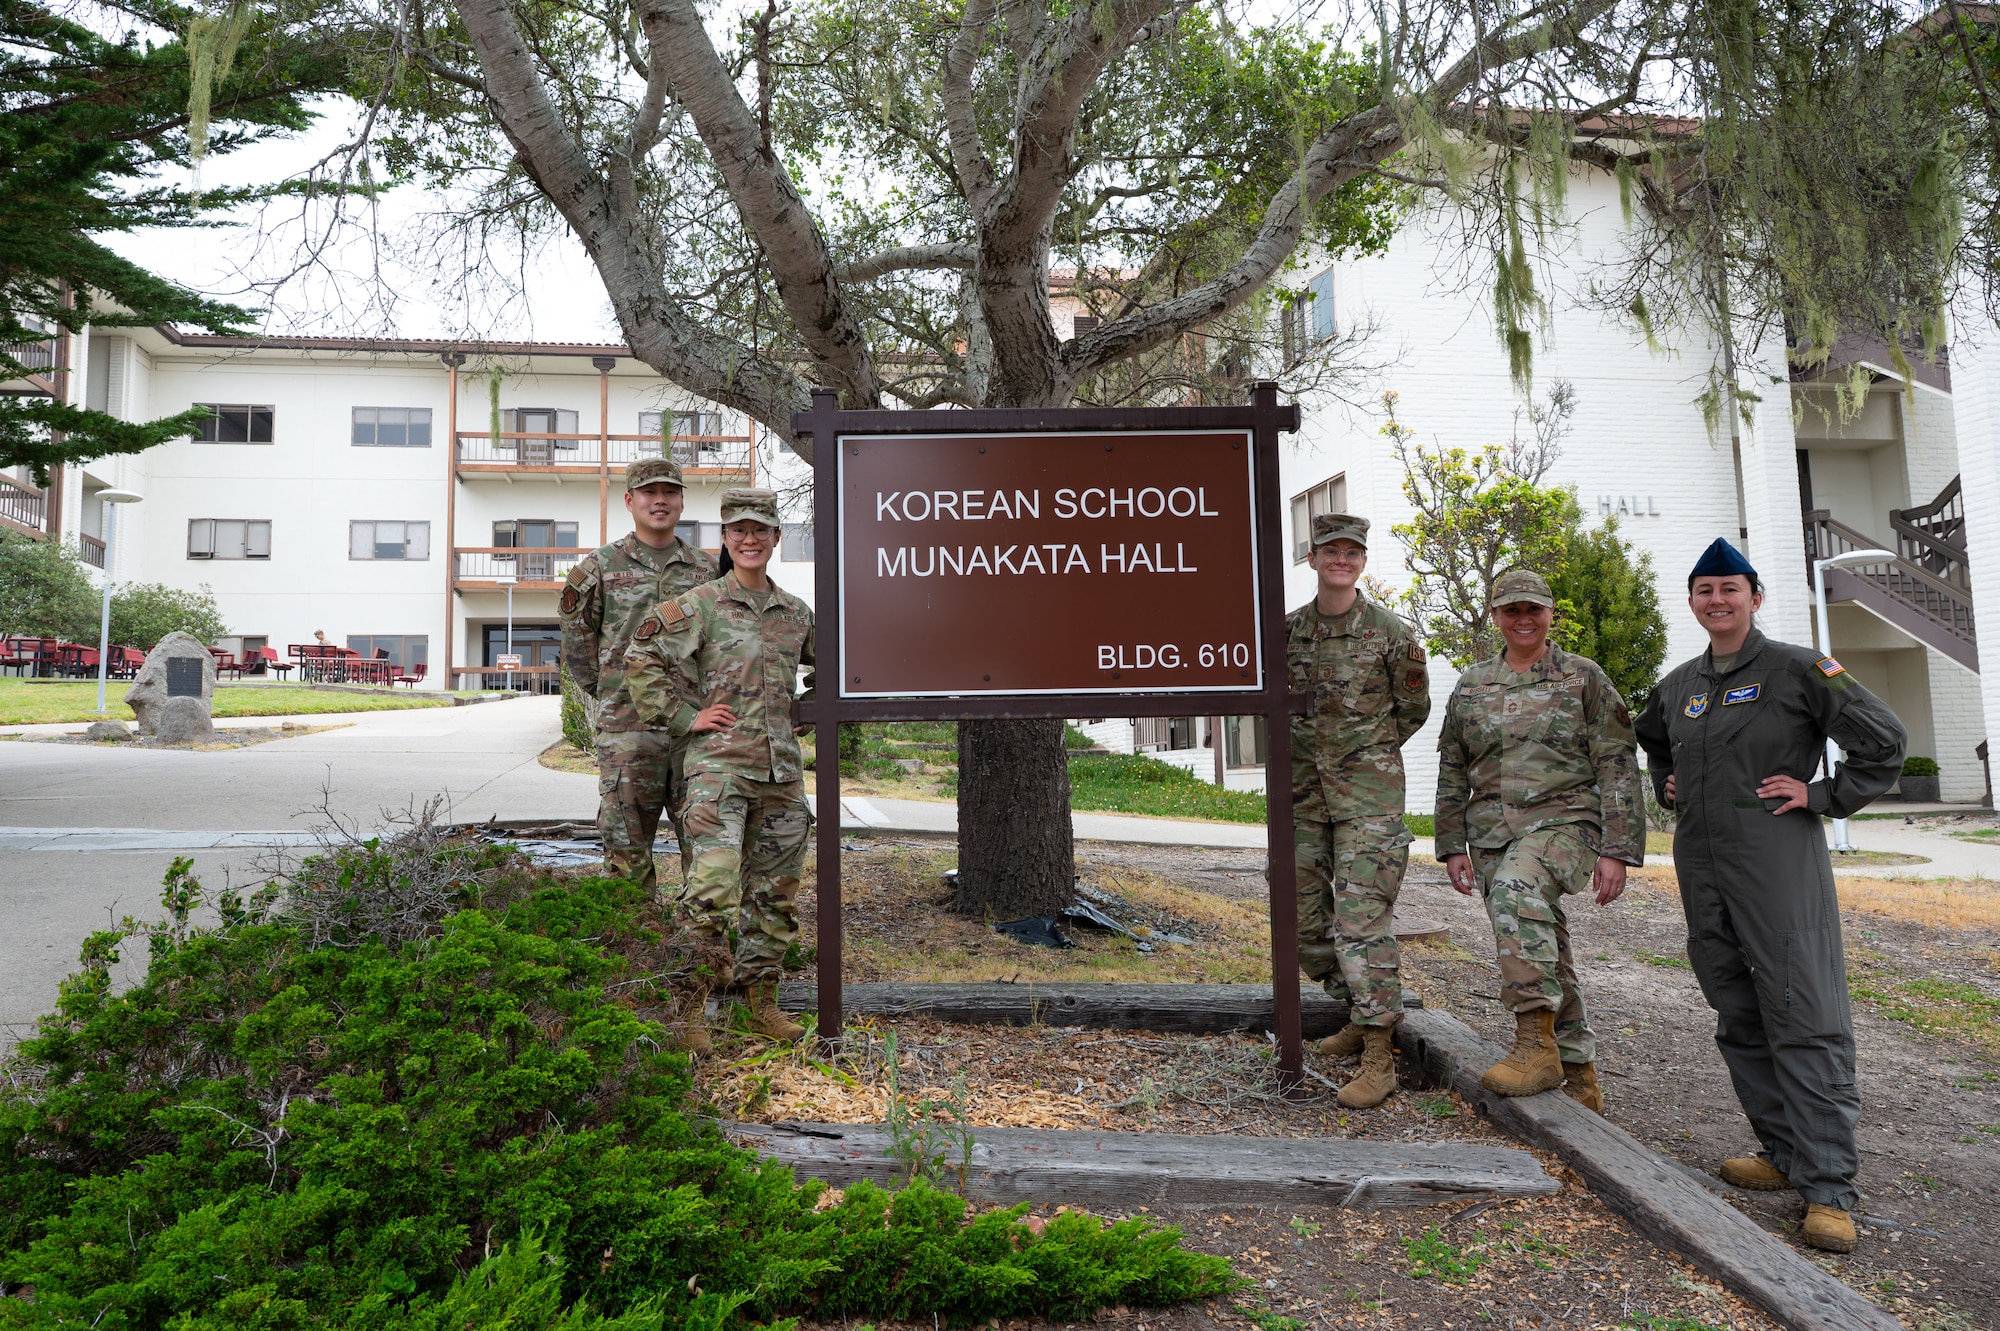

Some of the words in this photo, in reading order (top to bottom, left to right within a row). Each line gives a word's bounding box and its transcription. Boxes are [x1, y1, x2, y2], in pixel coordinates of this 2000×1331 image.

[877, 490, 1040, 521] KOREAN
[1054, 487, 1219, 518] SCHOOL
[1597, 495, 1660, 515] HALL
[877, 544, 1091, 577] MUNAKATA
[1101, 543, 1198, 573] HALL
[1097, 644, 1188, 669] BLDG.
[1198, 643, 1249, 668] 610
[1368, 641, 1387, 650] FORCE
[1563, 679, 1583, 688] FORCE
